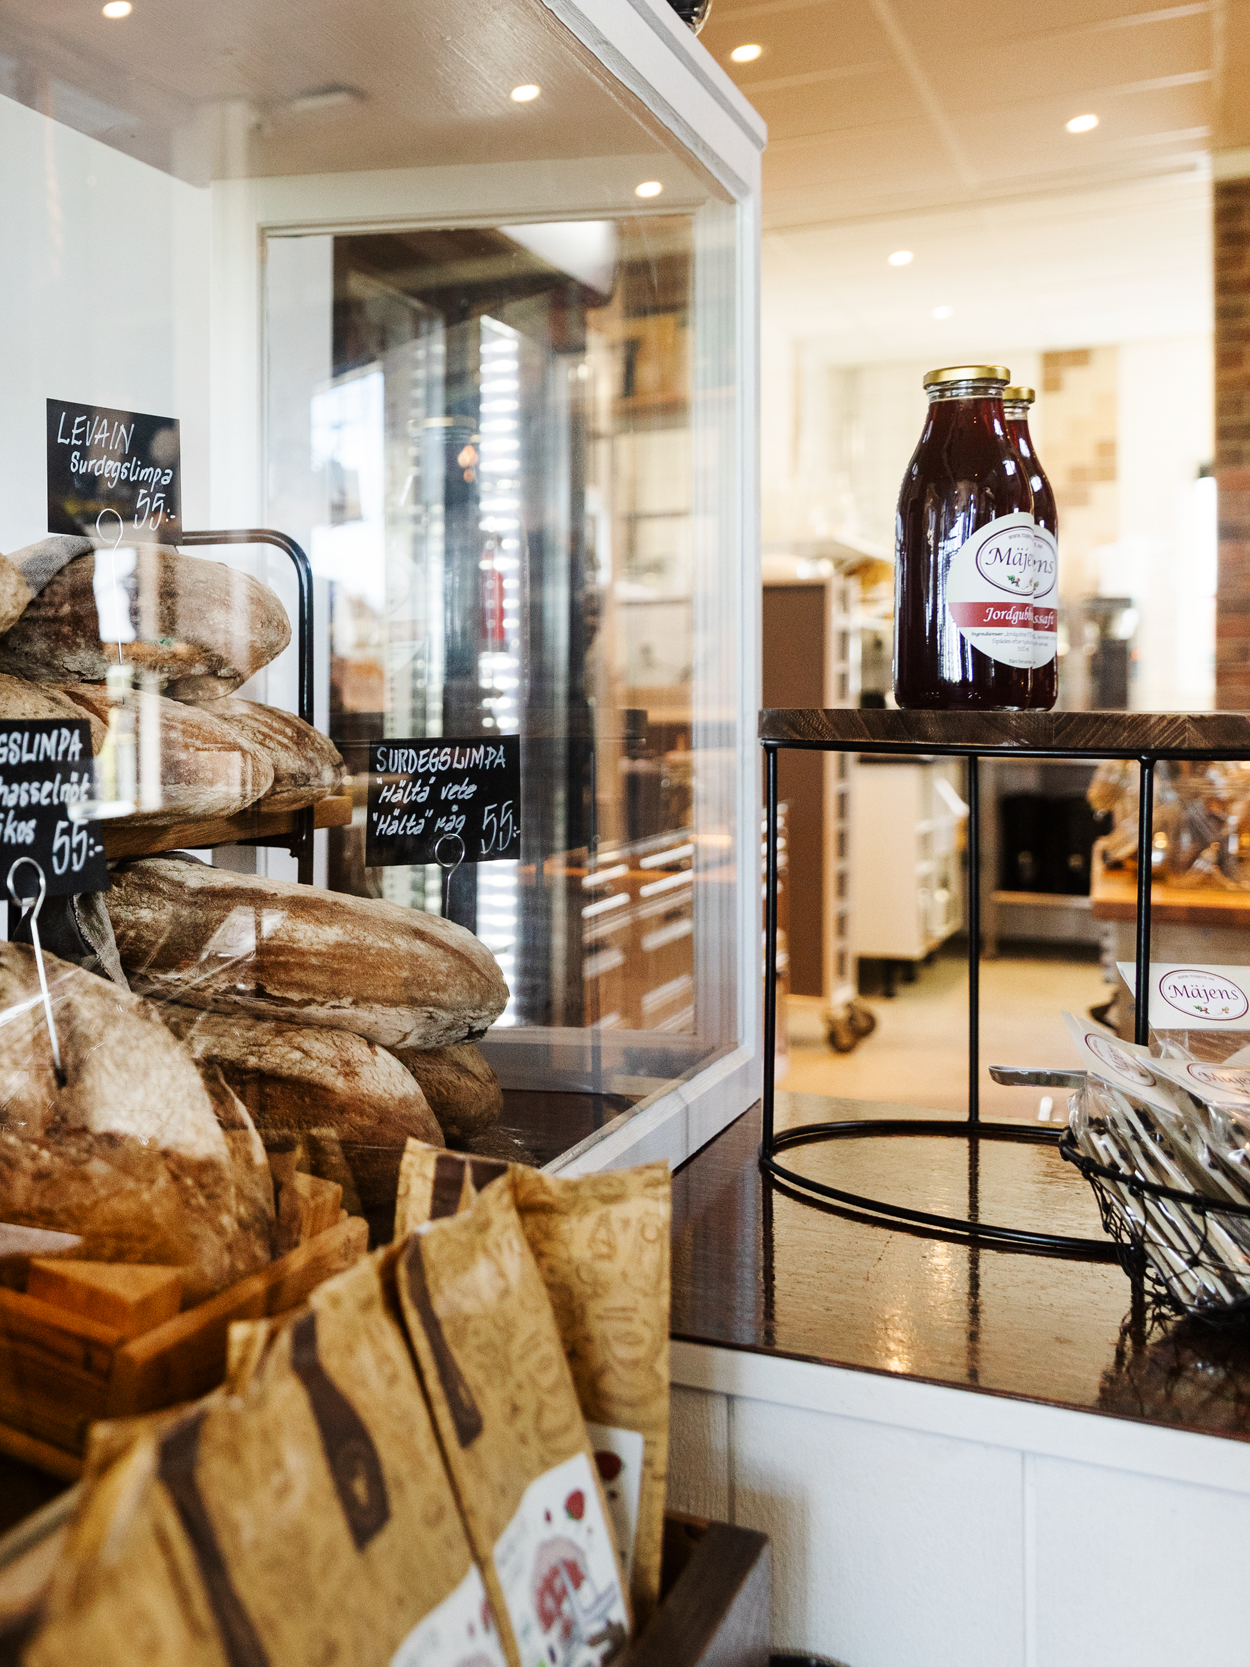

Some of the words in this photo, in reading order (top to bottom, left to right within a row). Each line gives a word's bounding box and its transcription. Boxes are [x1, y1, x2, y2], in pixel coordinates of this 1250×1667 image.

[57, 411, 135, 454] LEVAIN
[70, 451, 173, 492] Surdegslimpa
[133, 489, 176, 531] 55:-
[376, 744, 506, 774] SURDEGSLIMPA
[440, 777, 478, 801] vete
[434, 804, 466, 840] råg
[480, 800, 521, 855] 55:-
[52, 818, 104, 875] 55:-
[1168, 984, 1239, 1004] Mäjens
